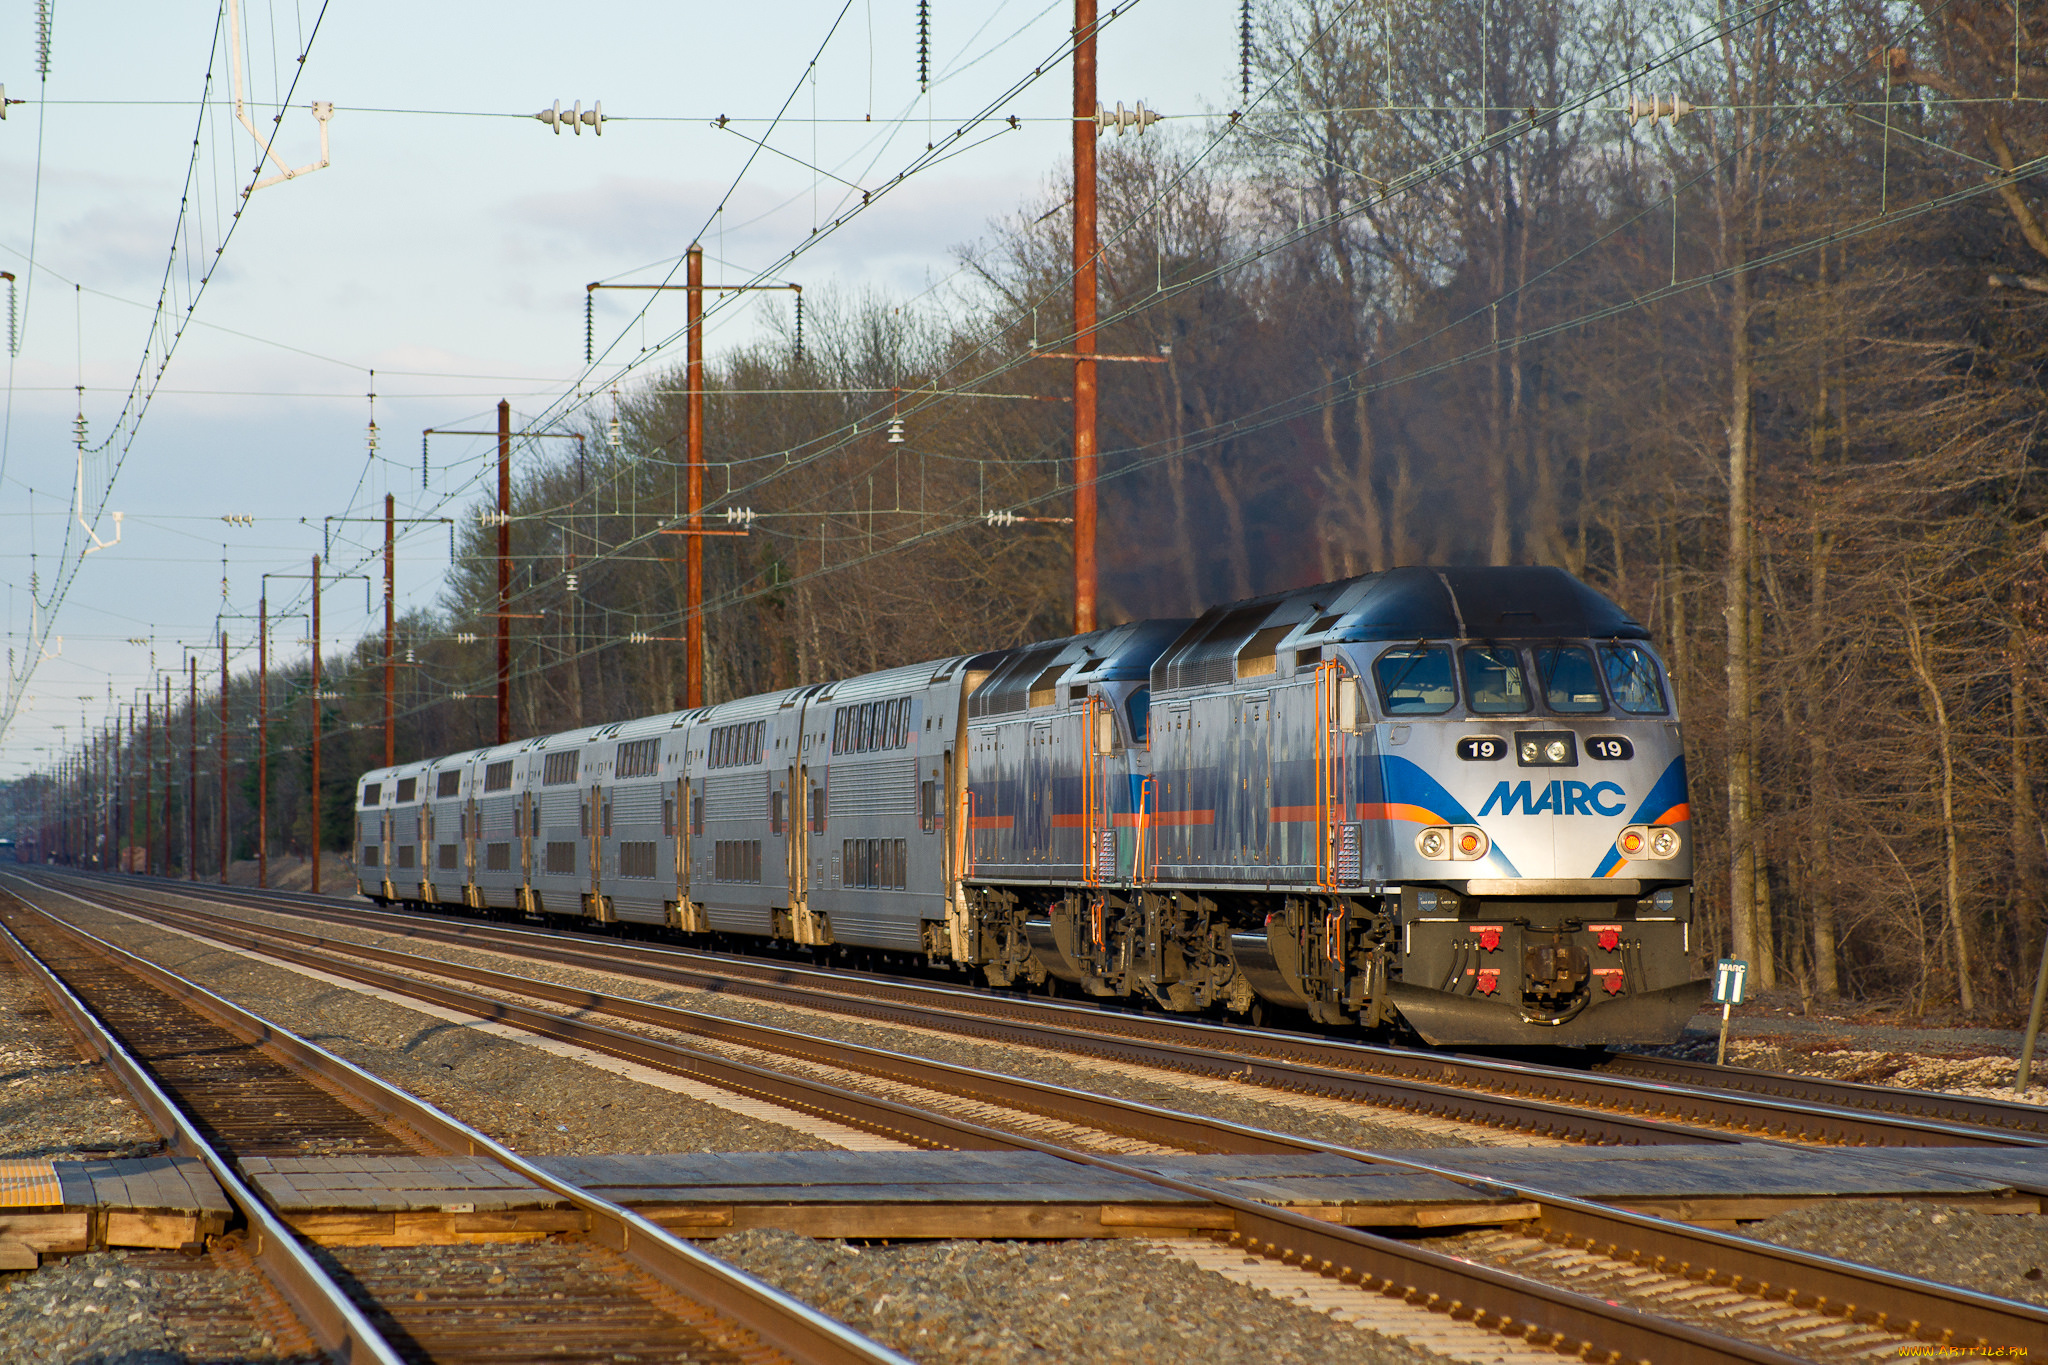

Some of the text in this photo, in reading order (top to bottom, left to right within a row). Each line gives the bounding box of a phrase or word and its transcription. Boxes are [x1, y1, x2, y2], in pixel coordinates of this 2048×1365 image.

[1468, 741, 1495, 758] 19
[1596, 741, 1623, 758] 19
[1476, 780, 1627, 817] MARC
[1718, 963, 1746, 973] MARC
